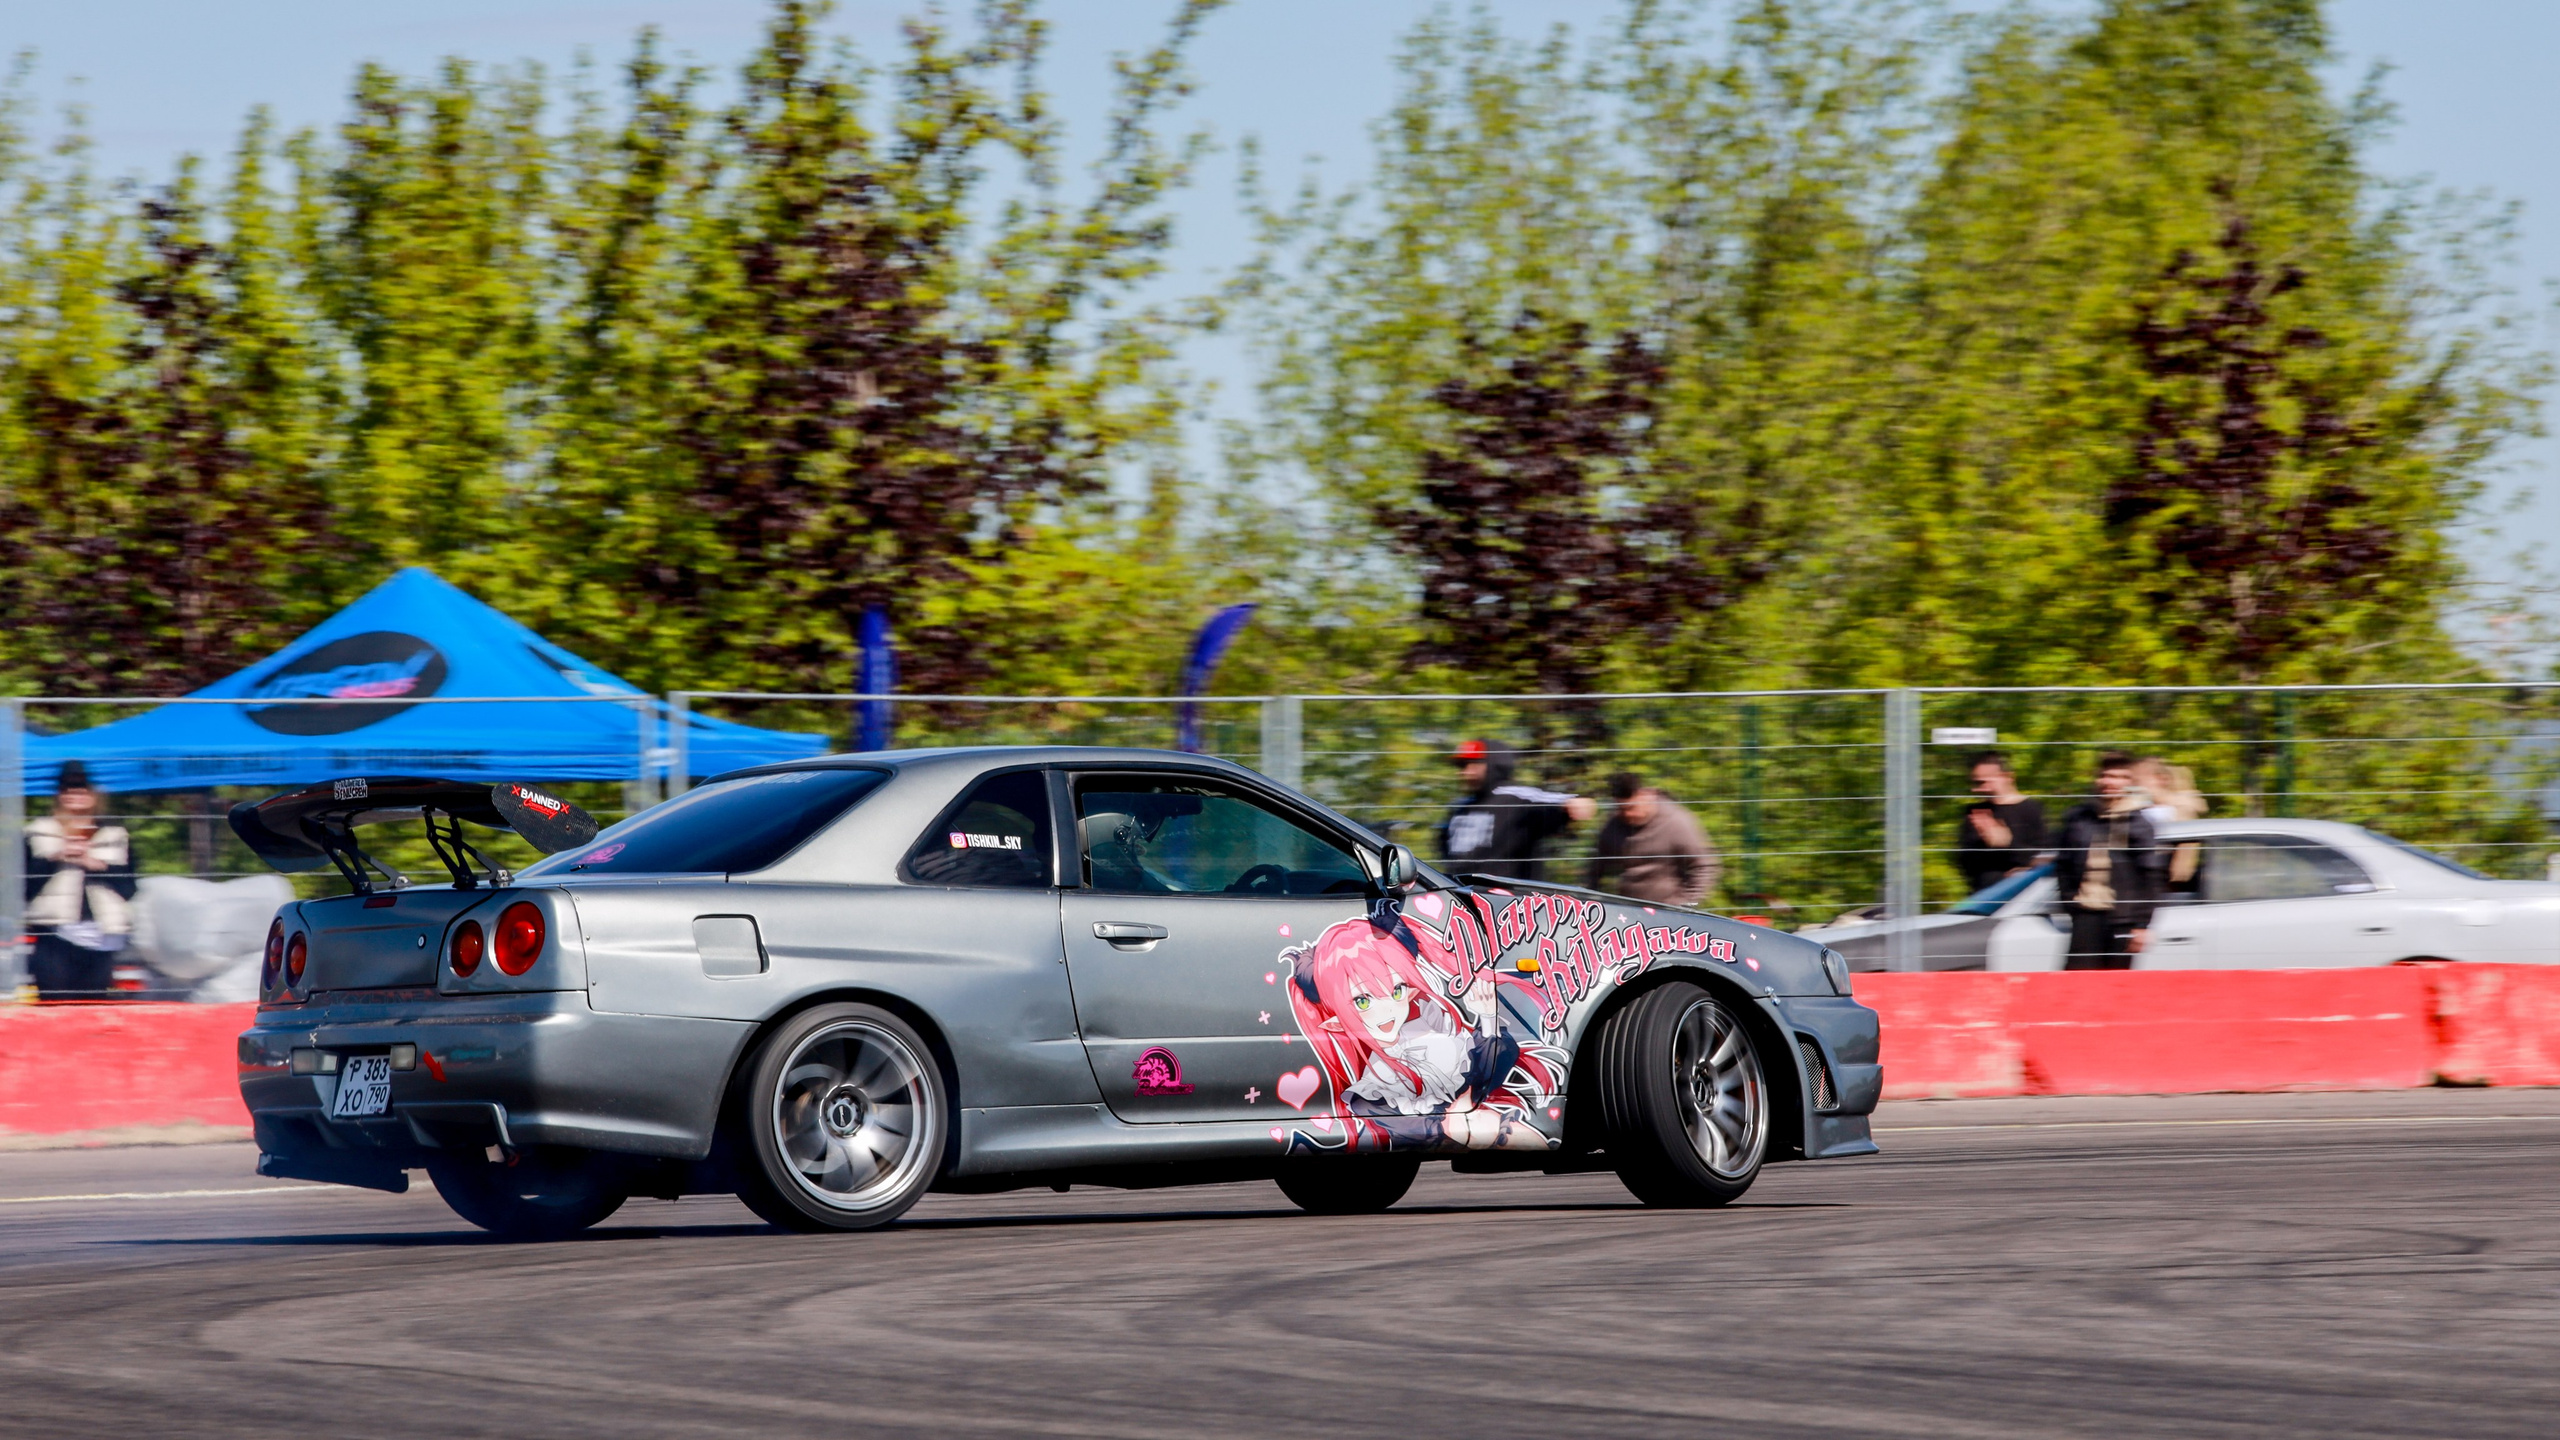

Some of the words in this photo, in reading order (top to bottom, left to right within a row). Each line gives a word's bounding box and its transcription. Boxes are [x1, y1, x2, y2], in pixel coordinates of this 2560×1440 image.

[965, 833, 1022, 850] TISHKIN_SKY
[364, 1058, 390, 1081] 383
[368, 1086, 387, 1105] 790
